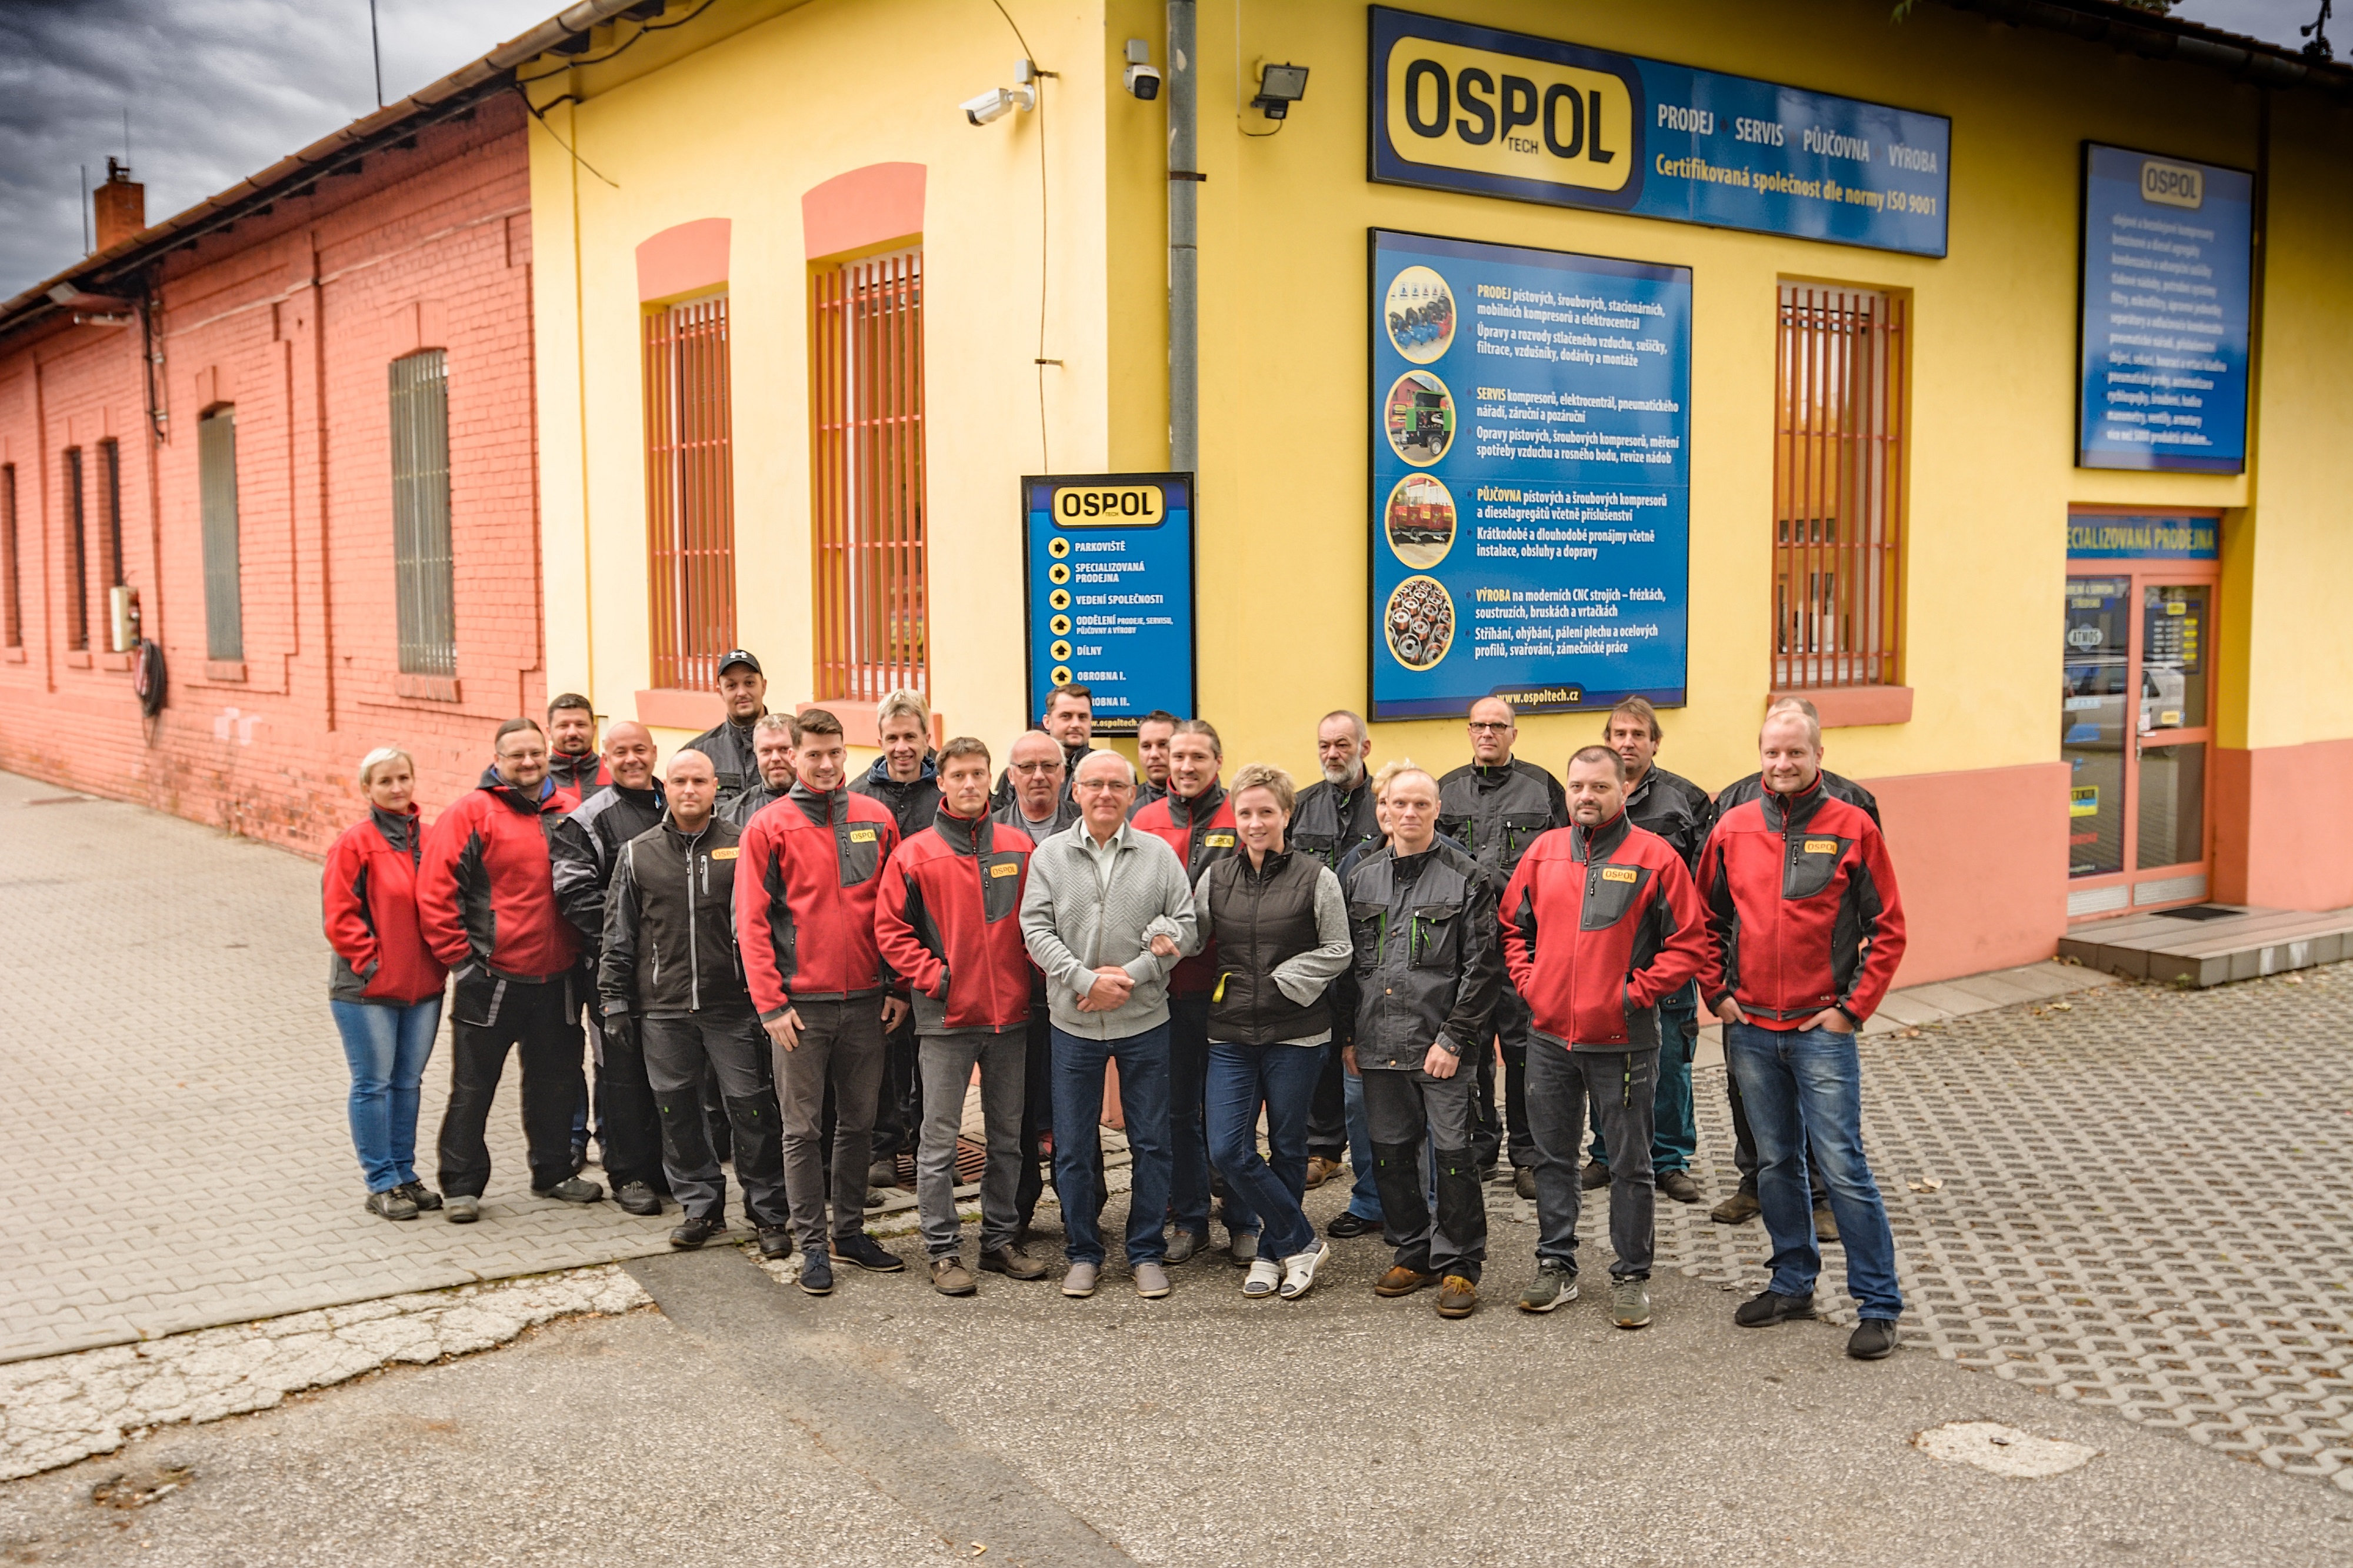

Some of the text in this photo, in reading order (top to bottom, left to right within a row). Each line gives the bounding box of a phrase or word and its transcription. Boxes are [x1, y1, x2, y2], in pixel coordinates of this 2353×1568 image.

[1405, 59, 1615, 164] OSPOL
[1508, 138, 1538, 154] TECH
[1658, 104, 1937, 174] PRODEJ SERVIS PŮJČOVNA VÝROBA
[1656, 153, 1936, 216] Certifikovaná společnost dle normy ISO 9001
[2147, 168, 2197, 199] OSPOL
[1478, 284, 1665, 318] PRODEJ pístových, šroubových, stacionárních,
[1478, 302, 1640, 329] mobilních kompresorů a elektrocentrál
[1478, 321, 1667, 355] Úpravy a rozvody stlačeného vzduchu, sušičky,
[1477, 341, 1638, 366] filtrace, vzdušníky, dodávky a montáže
[1477, 387, 1679, 412] SERVIS kompresorů, elektrocentrál, pneumatického
[1477, 404, 1586, 423] nářadí, záruční a pozáruční
[1477, 426, 1680, 449] Opravy pístových, šroubových kompresorů, měření
[1477, 443, 1672, 463] spotřeby vzduchu a rosného bodu, revize nádob
[1063, 492, 1154, 517] OSPOL
[1478, 485, 1667, 509] PŮJČOVNA pístových a šroubových kompresorů
[1477, 505, 1633, 523] a dieselagregátů včetně příslušenství
[1477, 526, 1655, 545] Krátkodobé a dlouhodobé pronájmy včetně
[2067, 525, 2214, 550] ECIALIZOVANÁ PRODEJNA
[1075, 541, 1126, 552] PARKOVIŠTĚ
[1477, 543, 1598, 561] instalace, obsluhy a dopravy
[1075, 561, 1145, 572] SPECIALIZOVANÁ
[1075, 573, 1119, 583] PRODEJNA
[1075, 593, 1164, 605] VEDENÍ SPOLEČNOSTI
[1476, 586, 1511, 602] VÝROBA
[1512, 592, 1523, 602] na
[1525, 589, 1571, 601] moderních
[1573, 588, 1589, 601] CNC
[1590, 588, 1621, 603] strojích
[1629, 588, 1666, 602] frézkách,
[1076, 614, 1116, 625] ODDĚLENÍ
[1475, 603, 1618, 620] soustruzích, bruskách a vrtačkách
[1475, 623, 1658, 642] Stříhání, ohýbání, pálení plechu a ocelových
[1077, 645, 1102, 656] DÍLNY
[1475, 640, 1628, 660] profilů, svařování, zámečnické práce
[1077, 671, 1126, 681] OBROBNA I.
[1092, 697, 1130, 706] ROBNA II.
[1091, 719, 1142, 729] w.ospoltech.
[1808, 843, 1835, 852] OSPOL
[992, 866, 1015, 875] OSPOL
[1606, 870, 1633, 880] OSPOL
